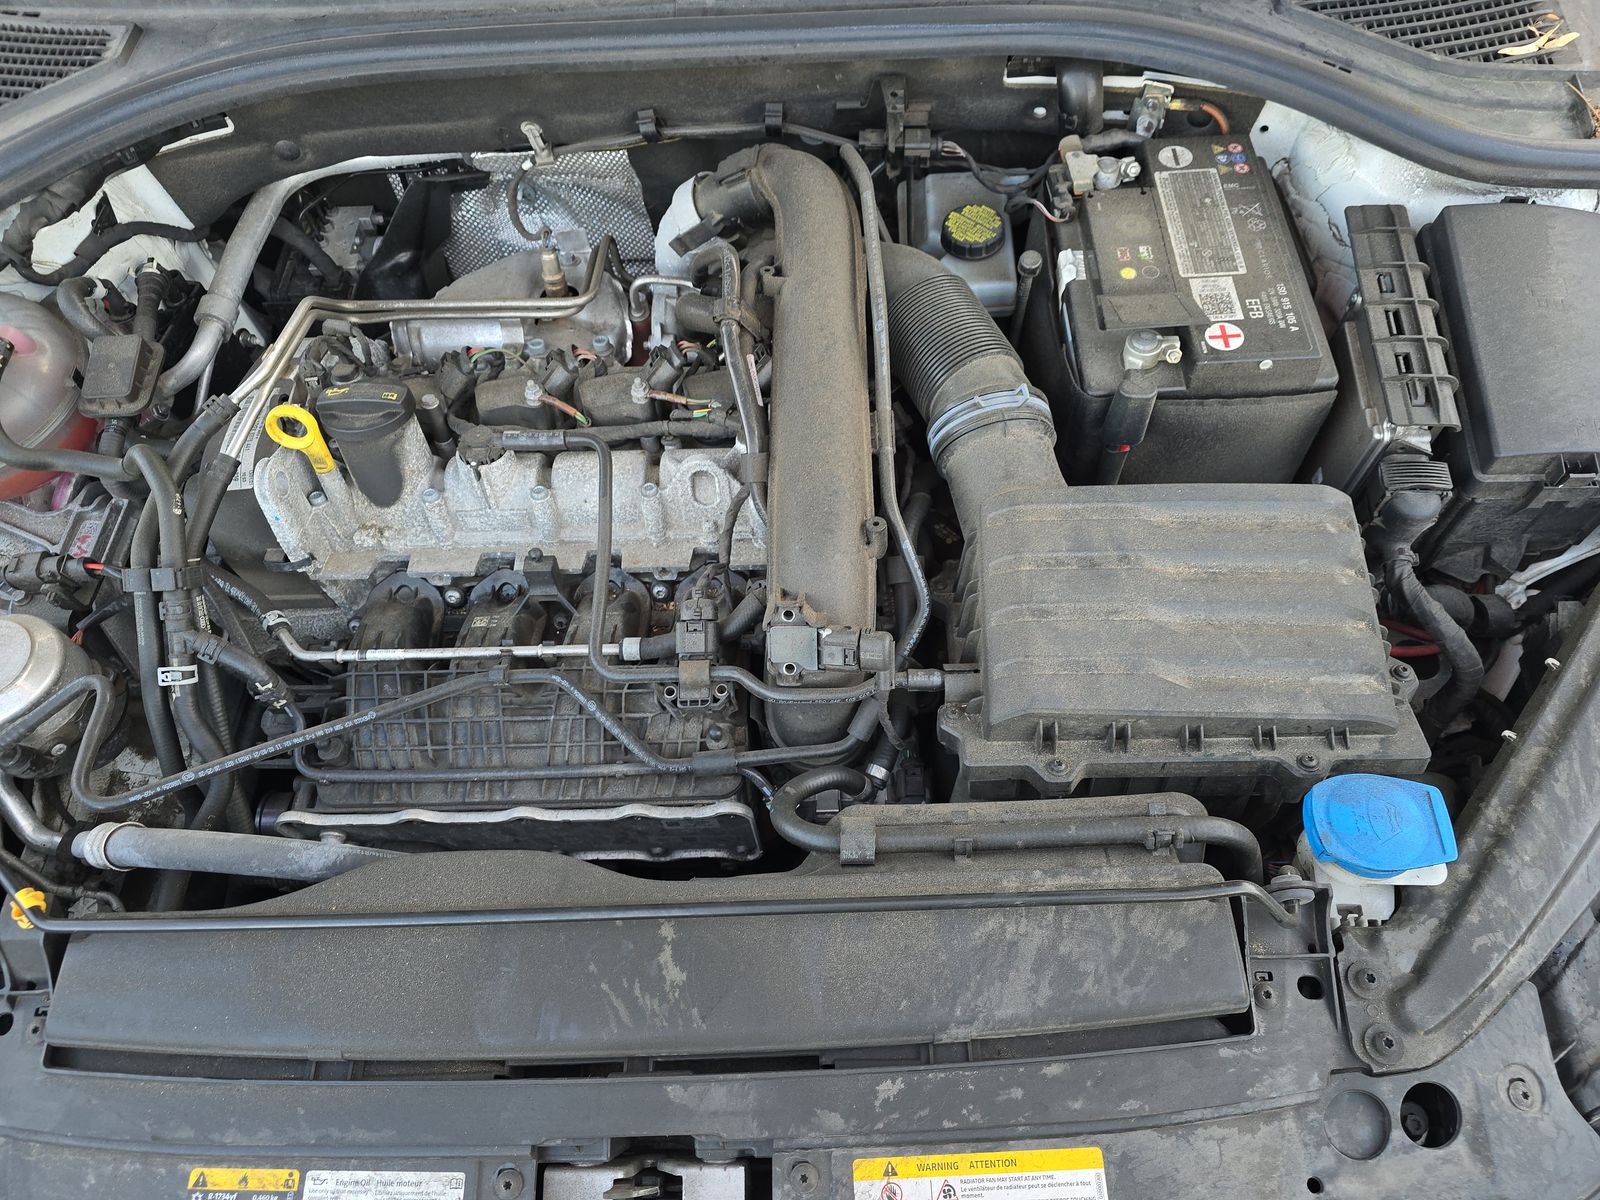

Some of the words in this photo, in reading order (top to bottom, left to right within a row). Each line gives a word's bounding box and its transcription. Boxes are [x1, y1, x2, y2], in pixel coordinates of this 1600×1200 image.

[1245, 298, 1264, 319] EFB
[1281, 297, 1292, 310] 915
[1286, 312, 1297, 324] 105
[916, 1162, 959, 1172] WARNING
[969, 1158, 1017, 1169] ATTENTION
[336, 1178, 359, 1188] Engine
[360, 1179, 370, 1187] Oil
[376, 1179, 395, 1187] Huile
